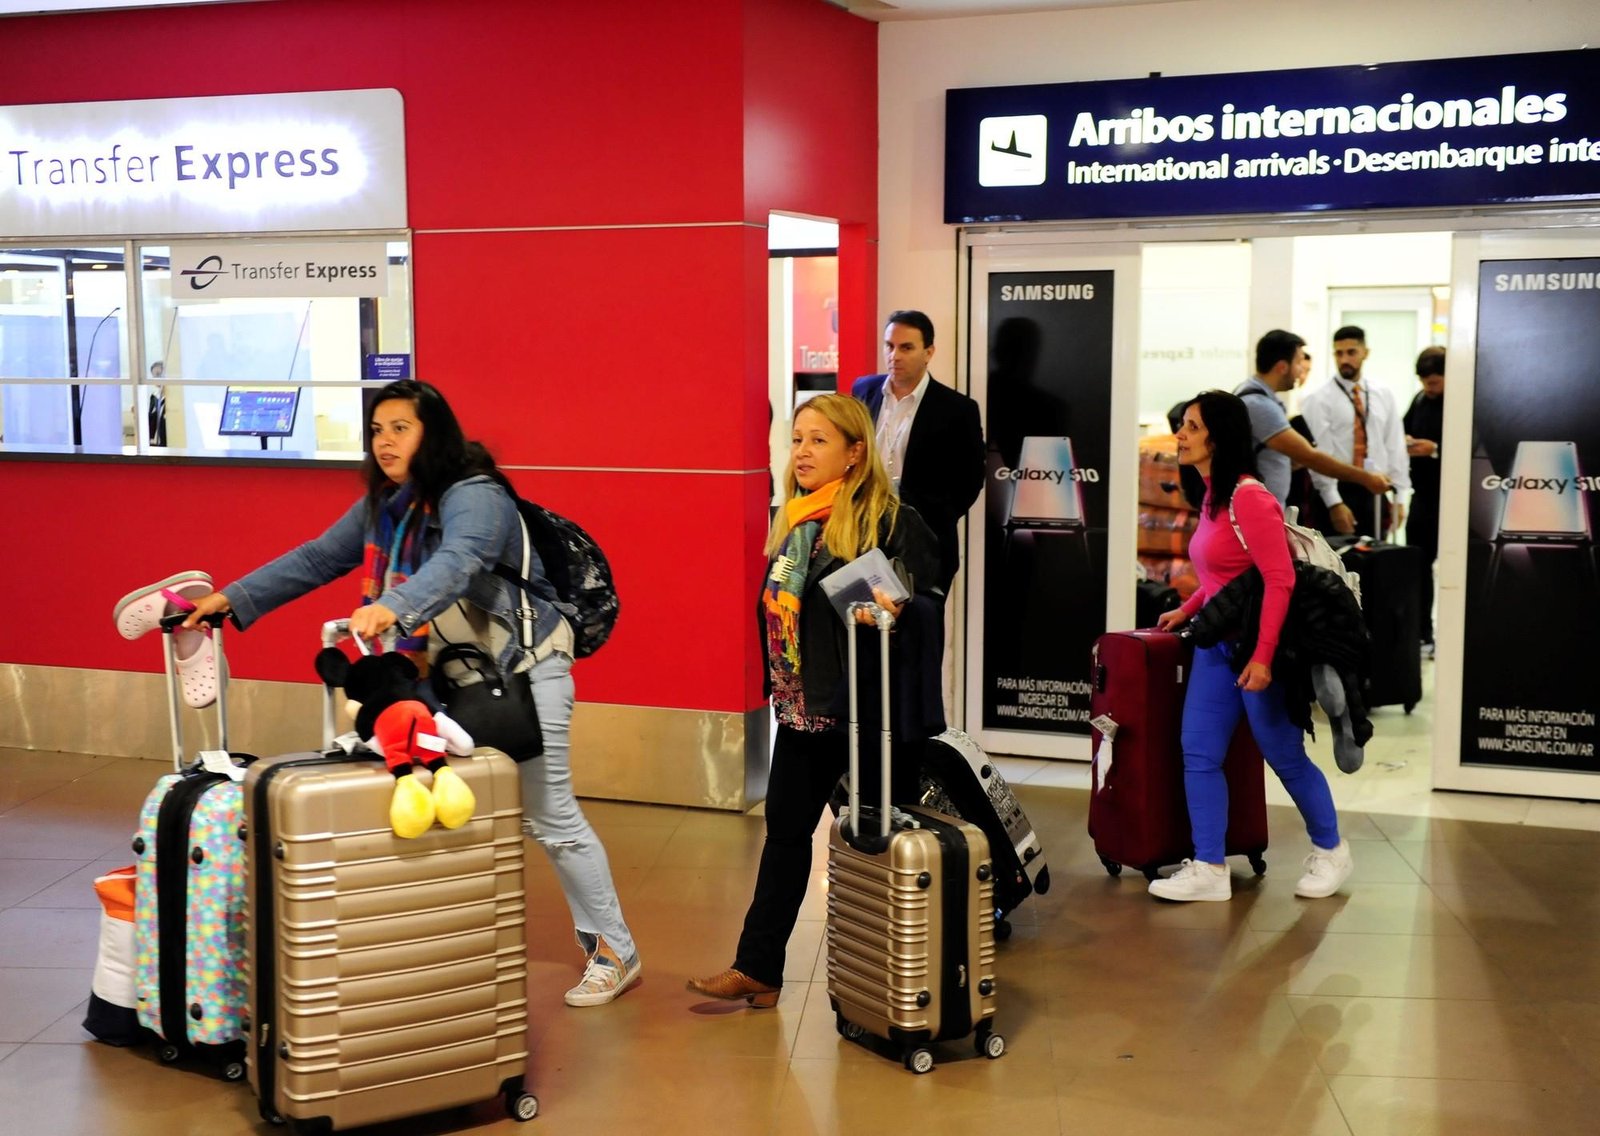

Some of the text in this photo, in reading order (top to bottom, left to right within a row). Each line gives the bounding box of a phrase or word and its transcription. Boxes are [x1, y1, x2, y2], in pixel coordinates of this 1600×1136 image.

[1068, 86, 1568, 147] Arribos internacionales
[8, 144, 340, 189] Transfer Express
[1067, 137, 1600, 185] International arrivals Desembarque inte
[231, 261, 377, 282] Transfer Express
[1001, 284, 1094, 301] SAMSUNG
[800, 344, 839, 369] Transfe
[994, 467, 1099, 485] Galaxy S10
[1481, 475, 1569, 494] Galaxy
[997, 677, 1017, 690] PARA
[1018, 692, 1069, 707] INGRESAR EN
[997, 705, 1090, 721] WWW.SAMSUNG.COM/AR
[1479, 707, 1504, 721] PARA
[1505, 724, 1567, 740] INGRESAR EN
[1478, 737, 1594, 756] WWW.SAMSUNG.COM/AR
